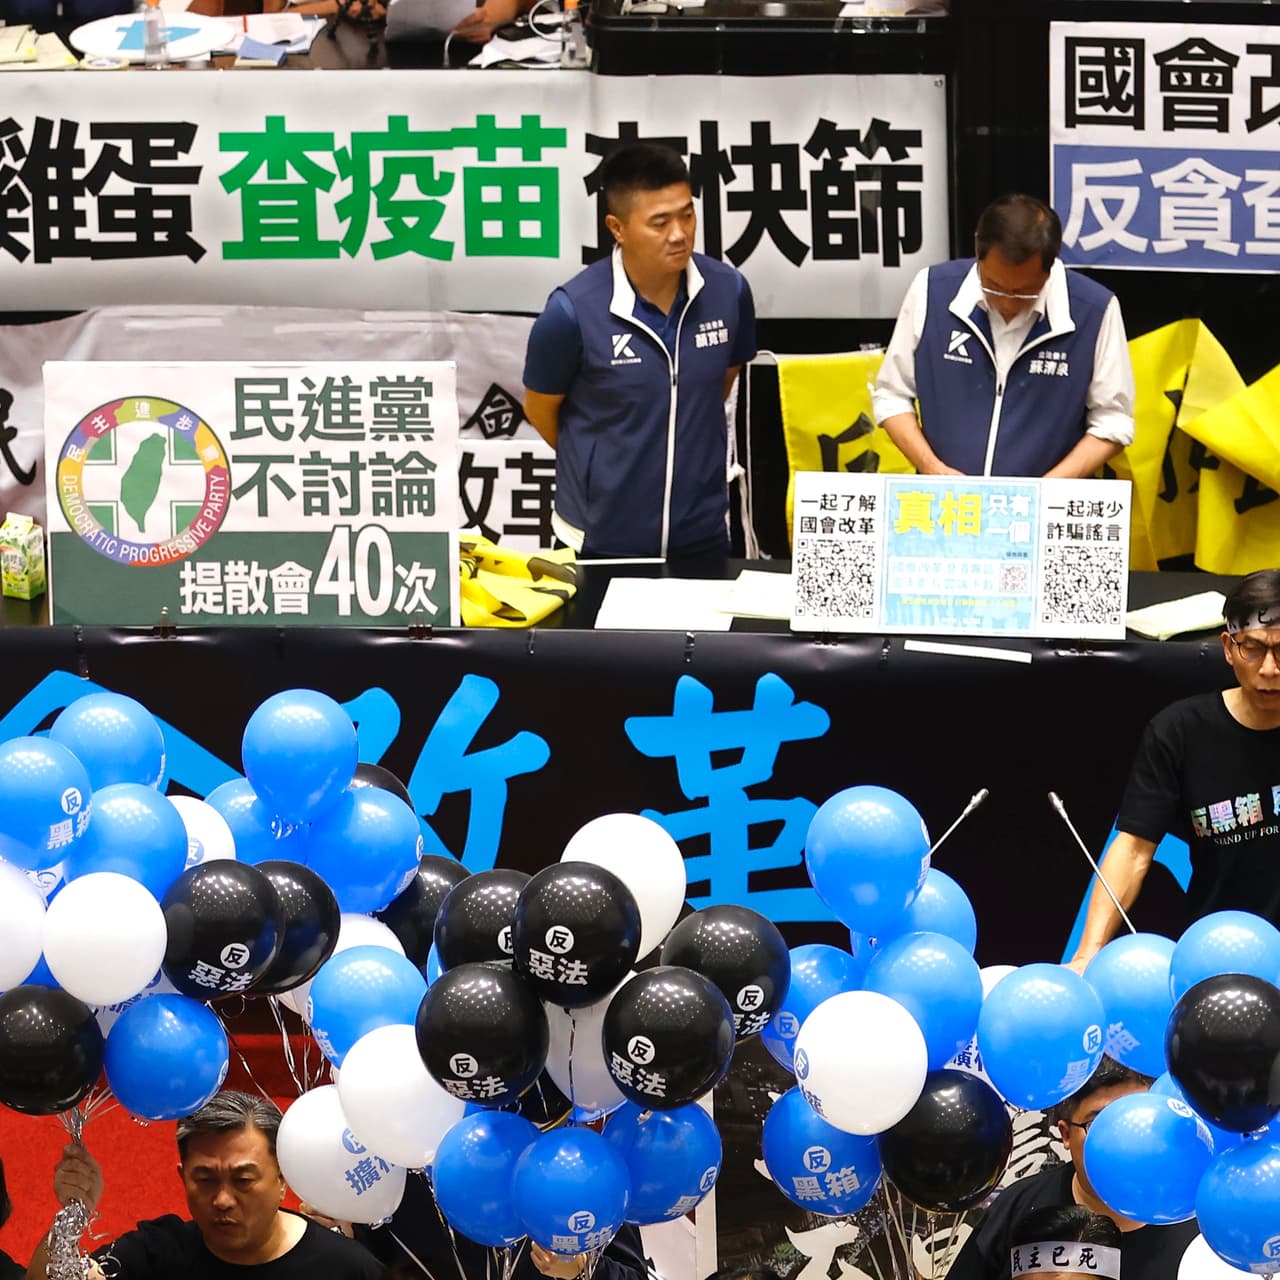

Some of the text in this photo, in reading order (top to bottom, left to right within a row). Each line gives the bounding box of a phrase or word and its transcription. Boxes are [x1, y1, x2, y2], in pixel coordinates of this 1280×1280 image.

[219, 113, 568, 263] 查疫苗
[230, 375, 435, 443] 民進黨
[232, 452, 438, 518] 不討論
[800, 493, 877, 512] 一起了解
[64, 474, 126, 558] DEMOCRATIC
[800, 515, 875, 535] 國會改革
[894, 491, 983, 535] 真相
[1047, 499, 1124, 518] 一起減少
[1046, 521, 1123, 541] 詐騙謠言
[179, 524, 439, 617] 提散會40次
[1260, 824, 1279, 838] FOR
[195, 960, 252, 994] 惡法
[527, 950, 590, 987] 惡法
[442, 1075, 510, 1102] 惡法
[611, 1056, 669, 1099] 惡法
[791, 1166, 862, 1202] 黑箱
[1012, 1245, 1098, 1271] 民主已死
